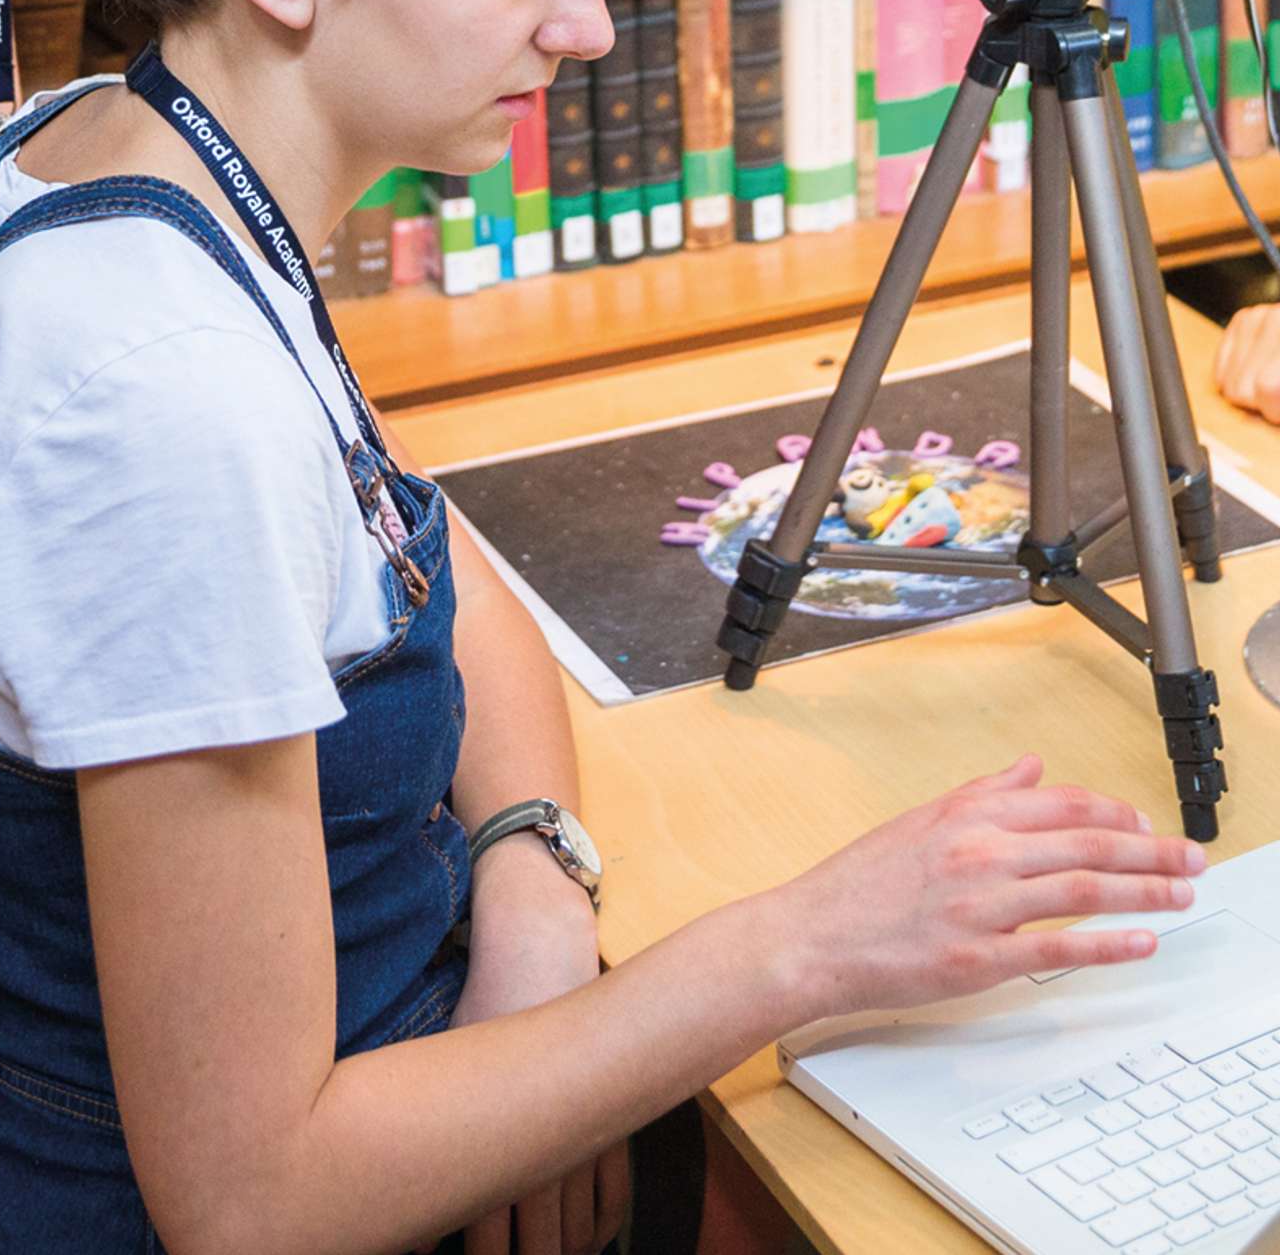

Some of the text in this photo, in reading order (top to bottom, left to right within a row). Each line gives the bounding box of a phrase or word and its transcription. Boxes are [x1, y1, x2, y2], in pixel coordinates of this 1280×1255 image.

[171, 96, 315, 303] Oxford Royale Academy
